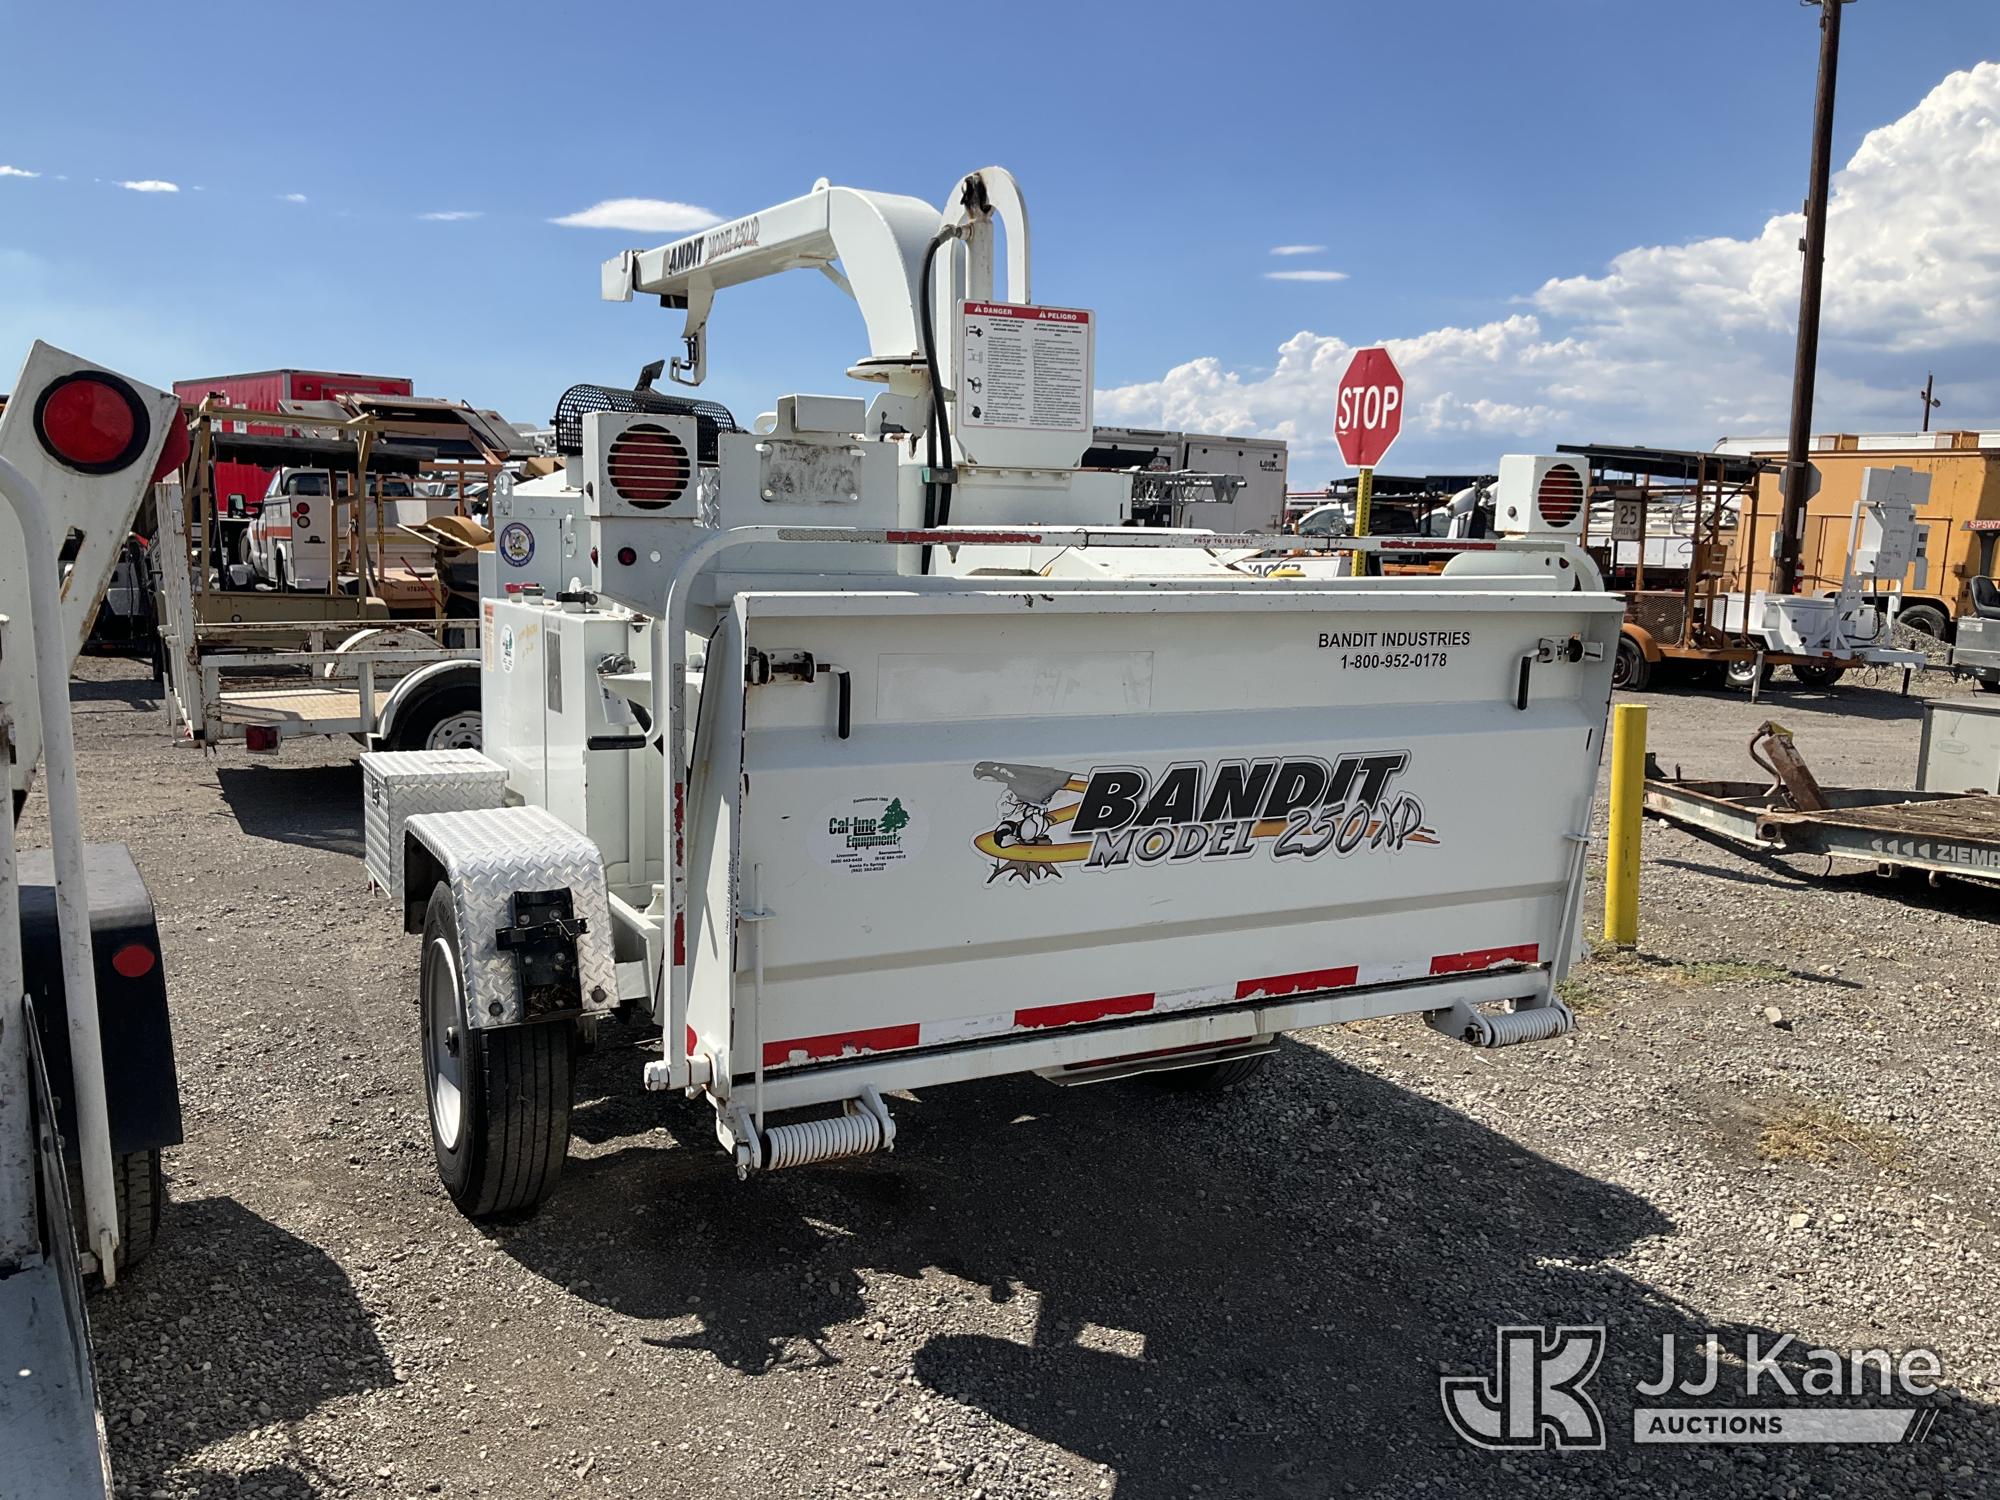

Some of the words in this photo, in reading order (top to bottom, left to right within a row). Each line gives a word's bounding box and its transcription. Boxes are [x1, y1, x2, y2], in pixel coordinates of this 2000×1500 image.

[667, 235, 705, 275] ANDIT
[707, 228, 732, 261] MODEL
[983, 307, 1013, 315] DANGER
[1047, 312, 1077, 320] PELIGRO
[1338, 385, 1399, 430] STOP
[1620, 504, 1637, 525] 25
[1318, 633, 1378, 648] BANDIT
[1381, 631, 1471, 646] INDUSTRIES
[1340, 653, 1447, 669] 1-800-952-0178
[1071, 753, 1406, 835] BANDIT
[829, 816, 876, 836] Cal-Line
[846, 833, 898, 851] Equipment
[1084, 819, 1256, 868] MODEL
[1936, 844, 2000, 867] ZIEMA
